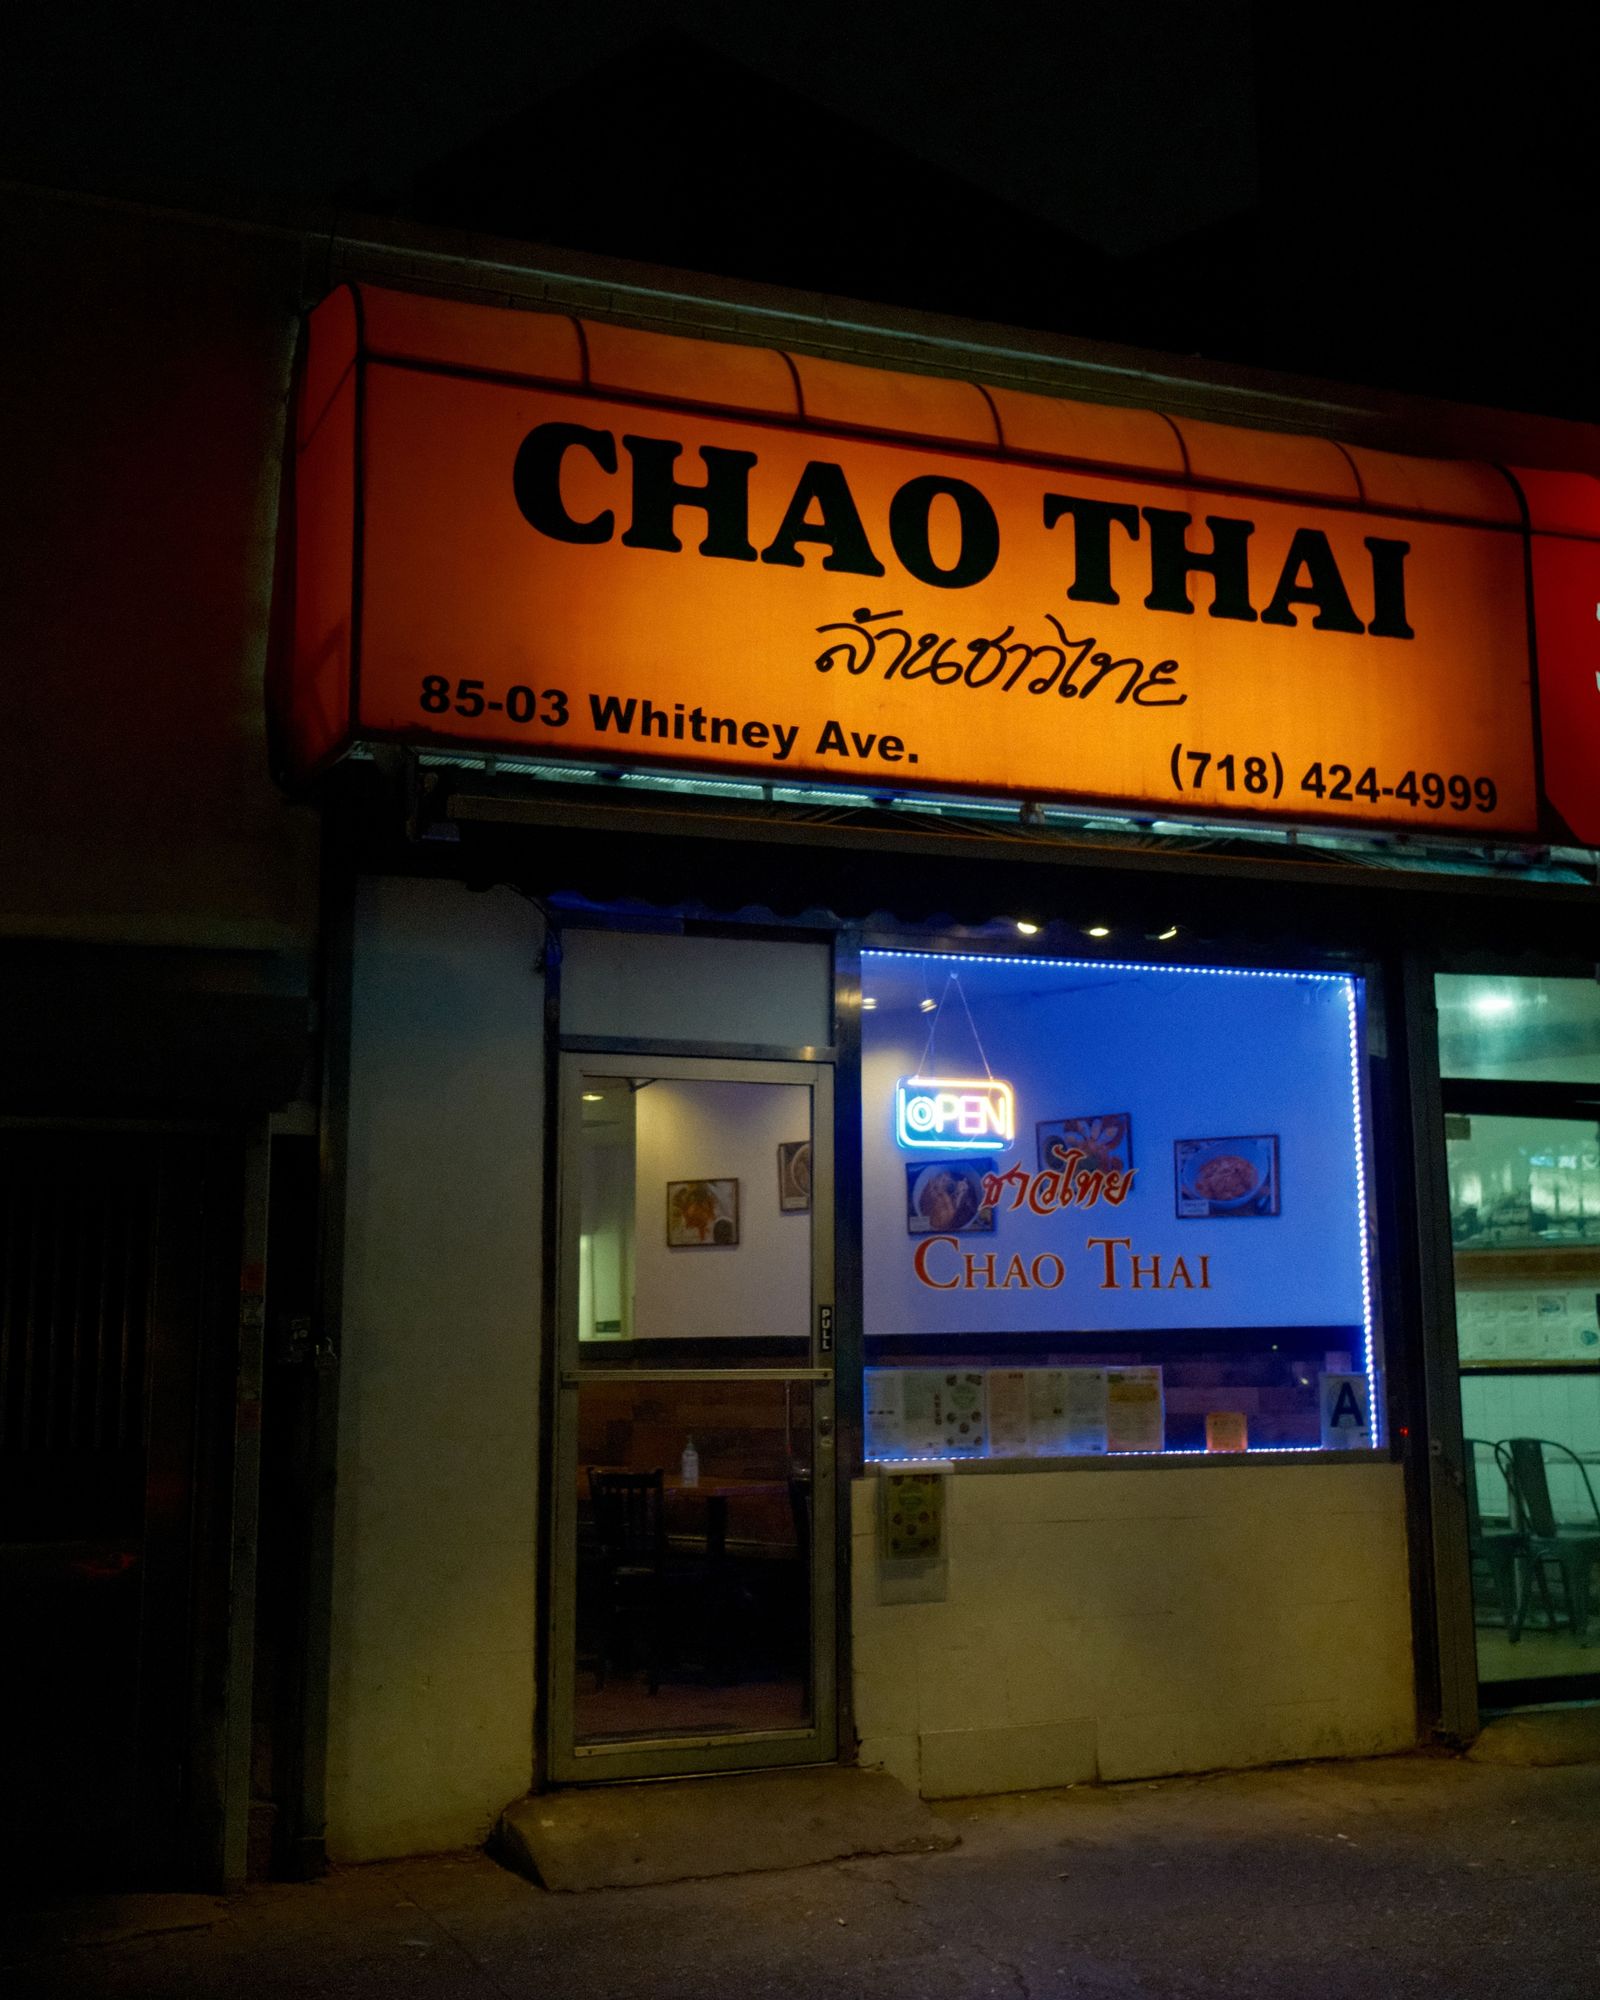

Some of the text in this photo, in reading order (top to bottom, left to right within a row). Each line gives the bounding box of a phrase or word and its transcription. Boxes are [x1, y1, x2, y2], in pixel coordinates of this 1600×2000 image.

[513, 421, 1414, 639] CHAO THAI
[419, 675, 919, 763] 85-03 Whitney Ave.
[1170, 743, 1498, 813] (718) 424-4999
[906, 1093, 1006, 1135] OPEN
[979, 1144, 1139, 1216] ชาวไทย
[913, 1235, 1212, 1291] CHAO THAI
[821, 1308, 831, 1350] PULL
[1330, 1382, 1364, 1428] A
